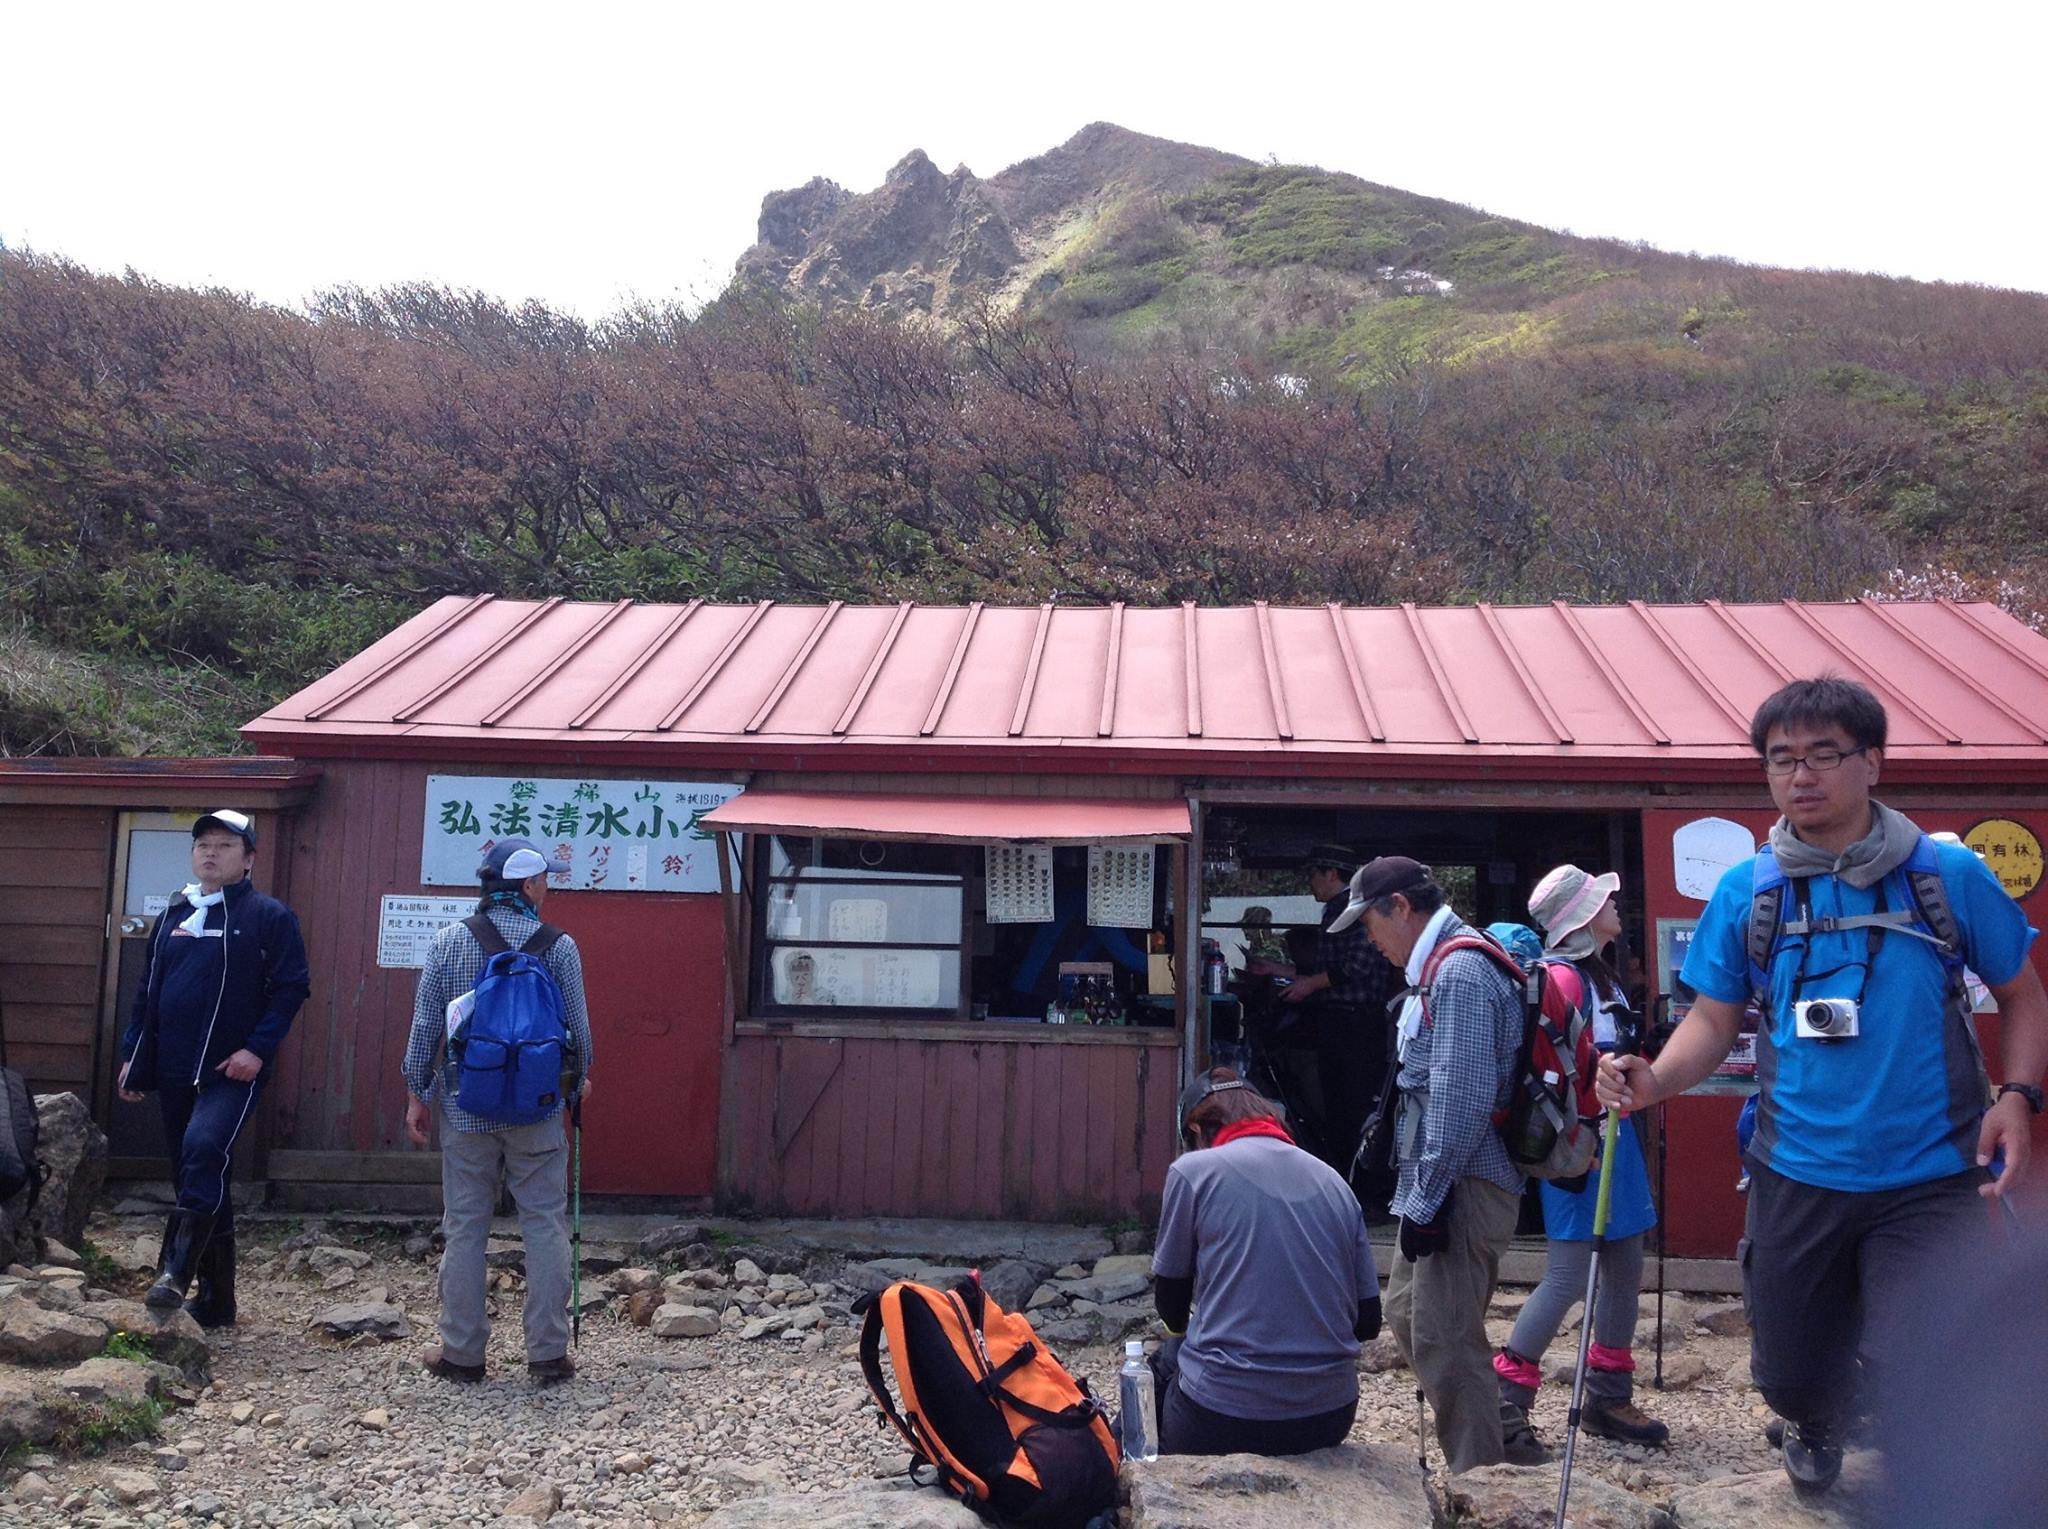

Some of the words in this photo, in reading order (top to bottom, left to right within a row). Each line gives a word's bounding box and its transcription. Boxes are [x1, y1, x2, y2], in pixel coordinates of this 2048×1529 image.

[510, 780, 661, 803] 磐梯山
[439, 799, 717, 841] 弘法清水小屋
[1972, 842, 2030, 858] 国有林
